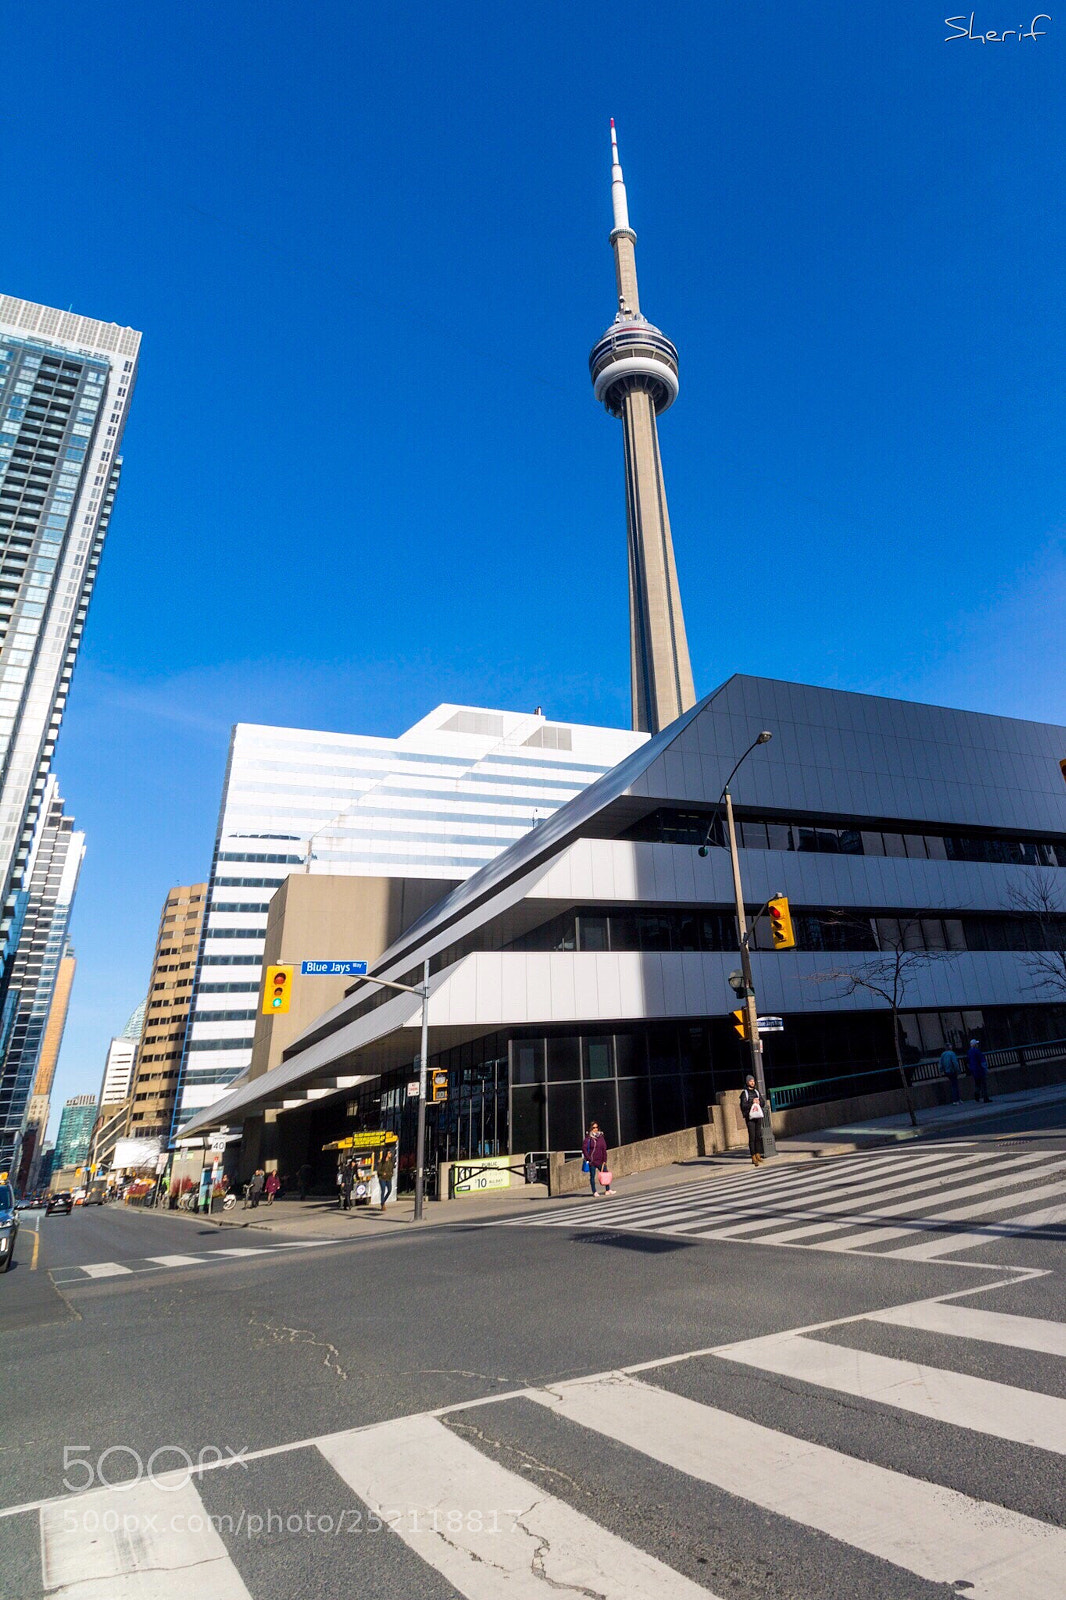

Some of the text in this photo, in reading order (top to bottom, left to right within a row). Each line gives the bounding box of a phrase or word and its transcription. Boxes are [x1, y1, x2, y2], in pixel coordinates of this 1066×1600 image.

[306, 962, 328, 972] Blue
[330, 962, 351, 974] Jays
[213, 1142, 225, 1150] 40
